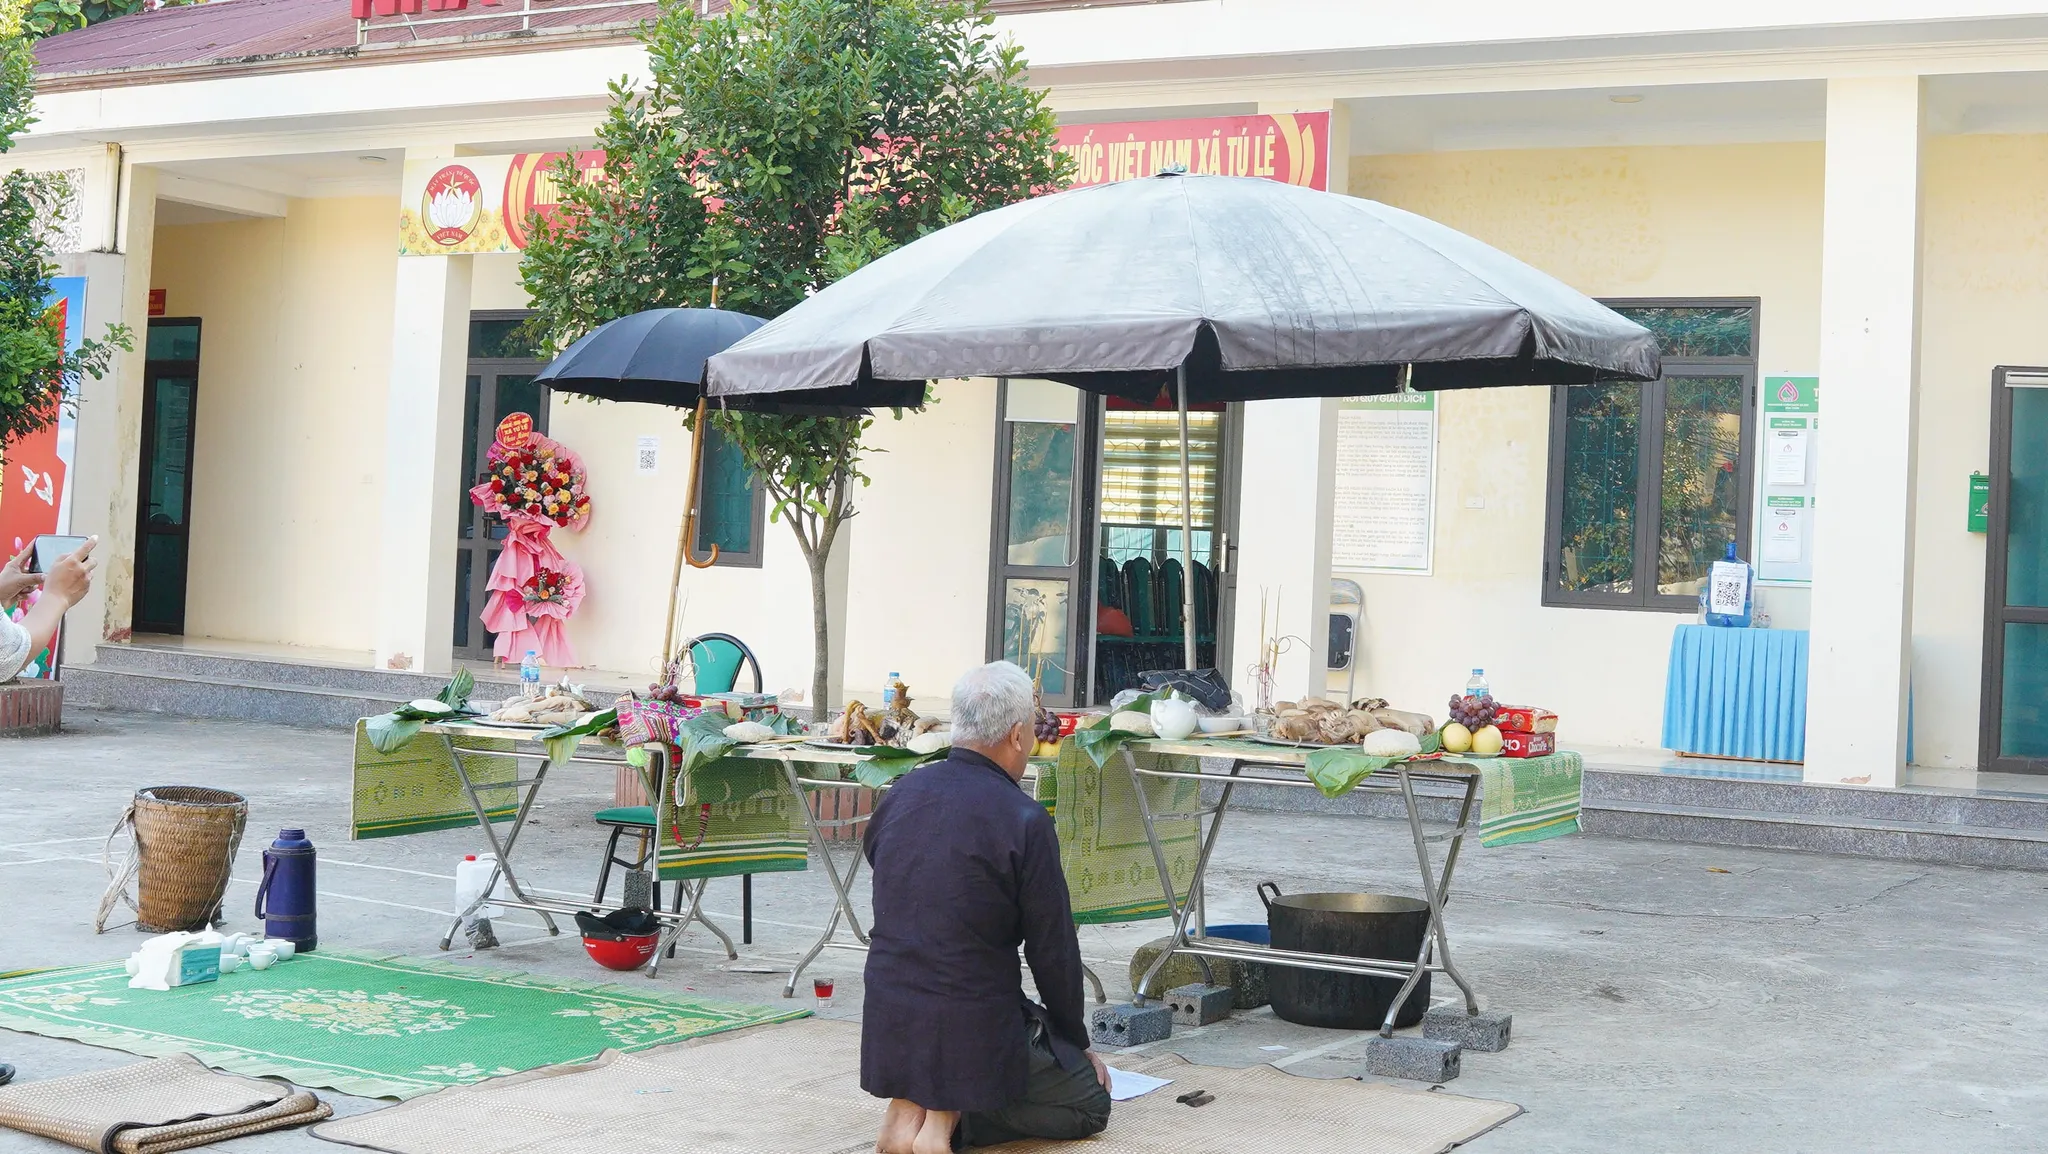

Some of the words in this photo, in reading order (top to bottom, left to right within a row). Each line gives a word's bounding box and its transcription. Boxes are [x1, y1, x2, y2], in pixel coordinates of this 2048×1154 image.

[1149, 139, 1193, 176] NAM
[1198, 129, 1221, 176] XÃ
[1227, 127, 1250, 177] TÚ
